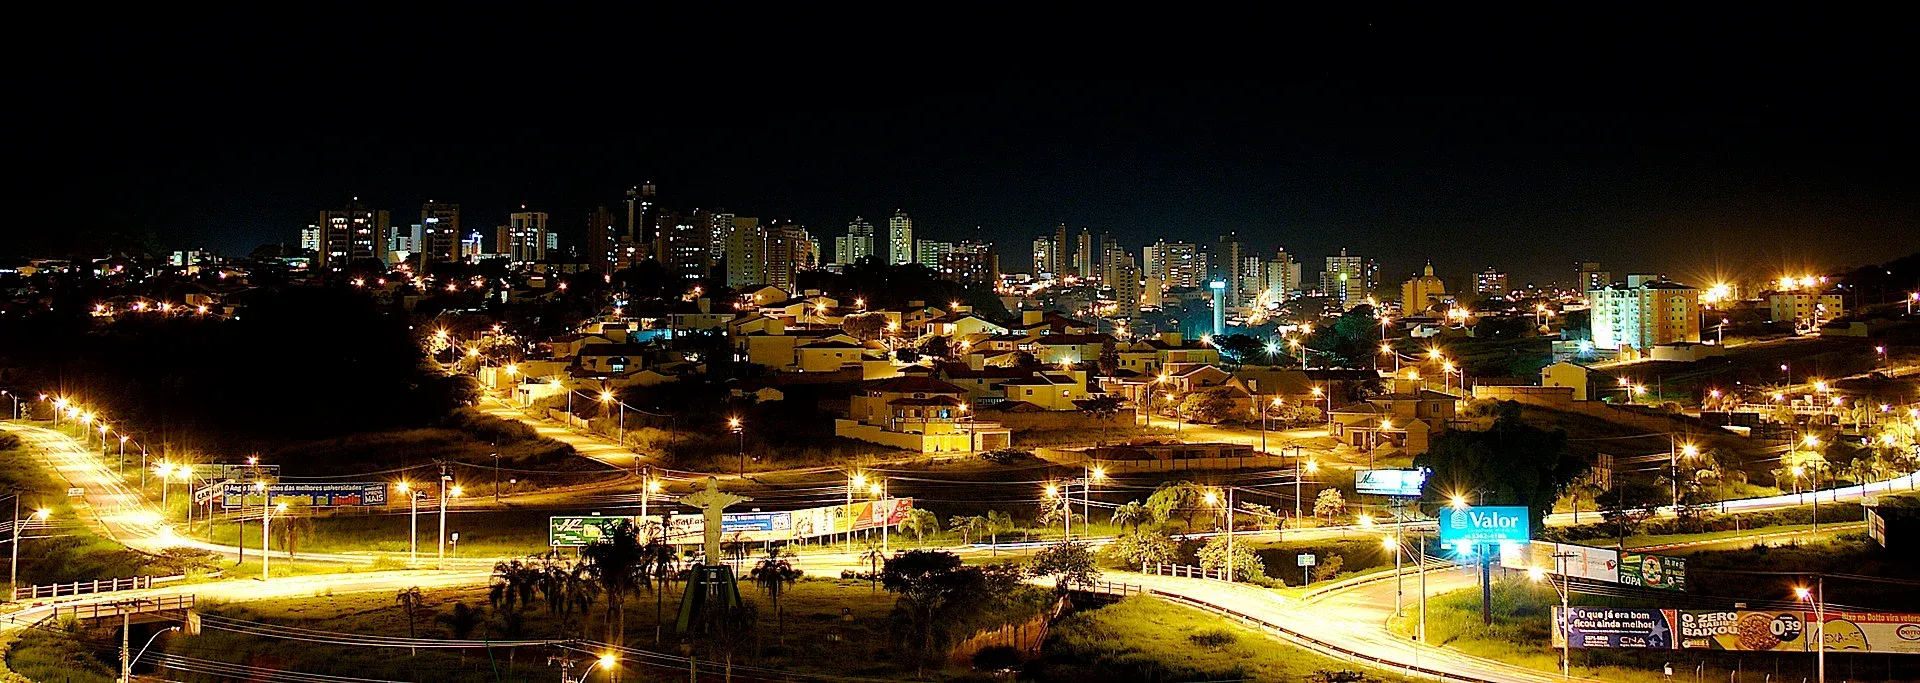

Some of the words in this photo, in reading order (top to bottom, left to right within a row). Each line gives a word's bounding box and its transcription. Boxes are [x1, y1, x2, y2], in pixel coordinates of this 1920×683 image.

[230, 484, 247, 492] Ango
[1469, 512, 1519, 528] Valor
[1620, 575, 1642, 587] COPA
[1578, 609, 1586, 619] O
[1586, 611, 1604, 620] que
[1604, 610, 1614, 620] já
[1630, 611, 1650, 619] bom
[1681, 613, 1694, 623] O
[1698, 612, 1739, 623] ZERO
[1867, 613, 1885, 621] Dotto
[1886, 613, 1899, 621] vira
[1573, 619, 1596, 627] ficou
[1597, 619, 1620, 628] ainda
[1622, 620, 1655, 629] melhor!
[1682, 621, 1697, 629] DO
[1619, 636, 1646, 644] CNA
